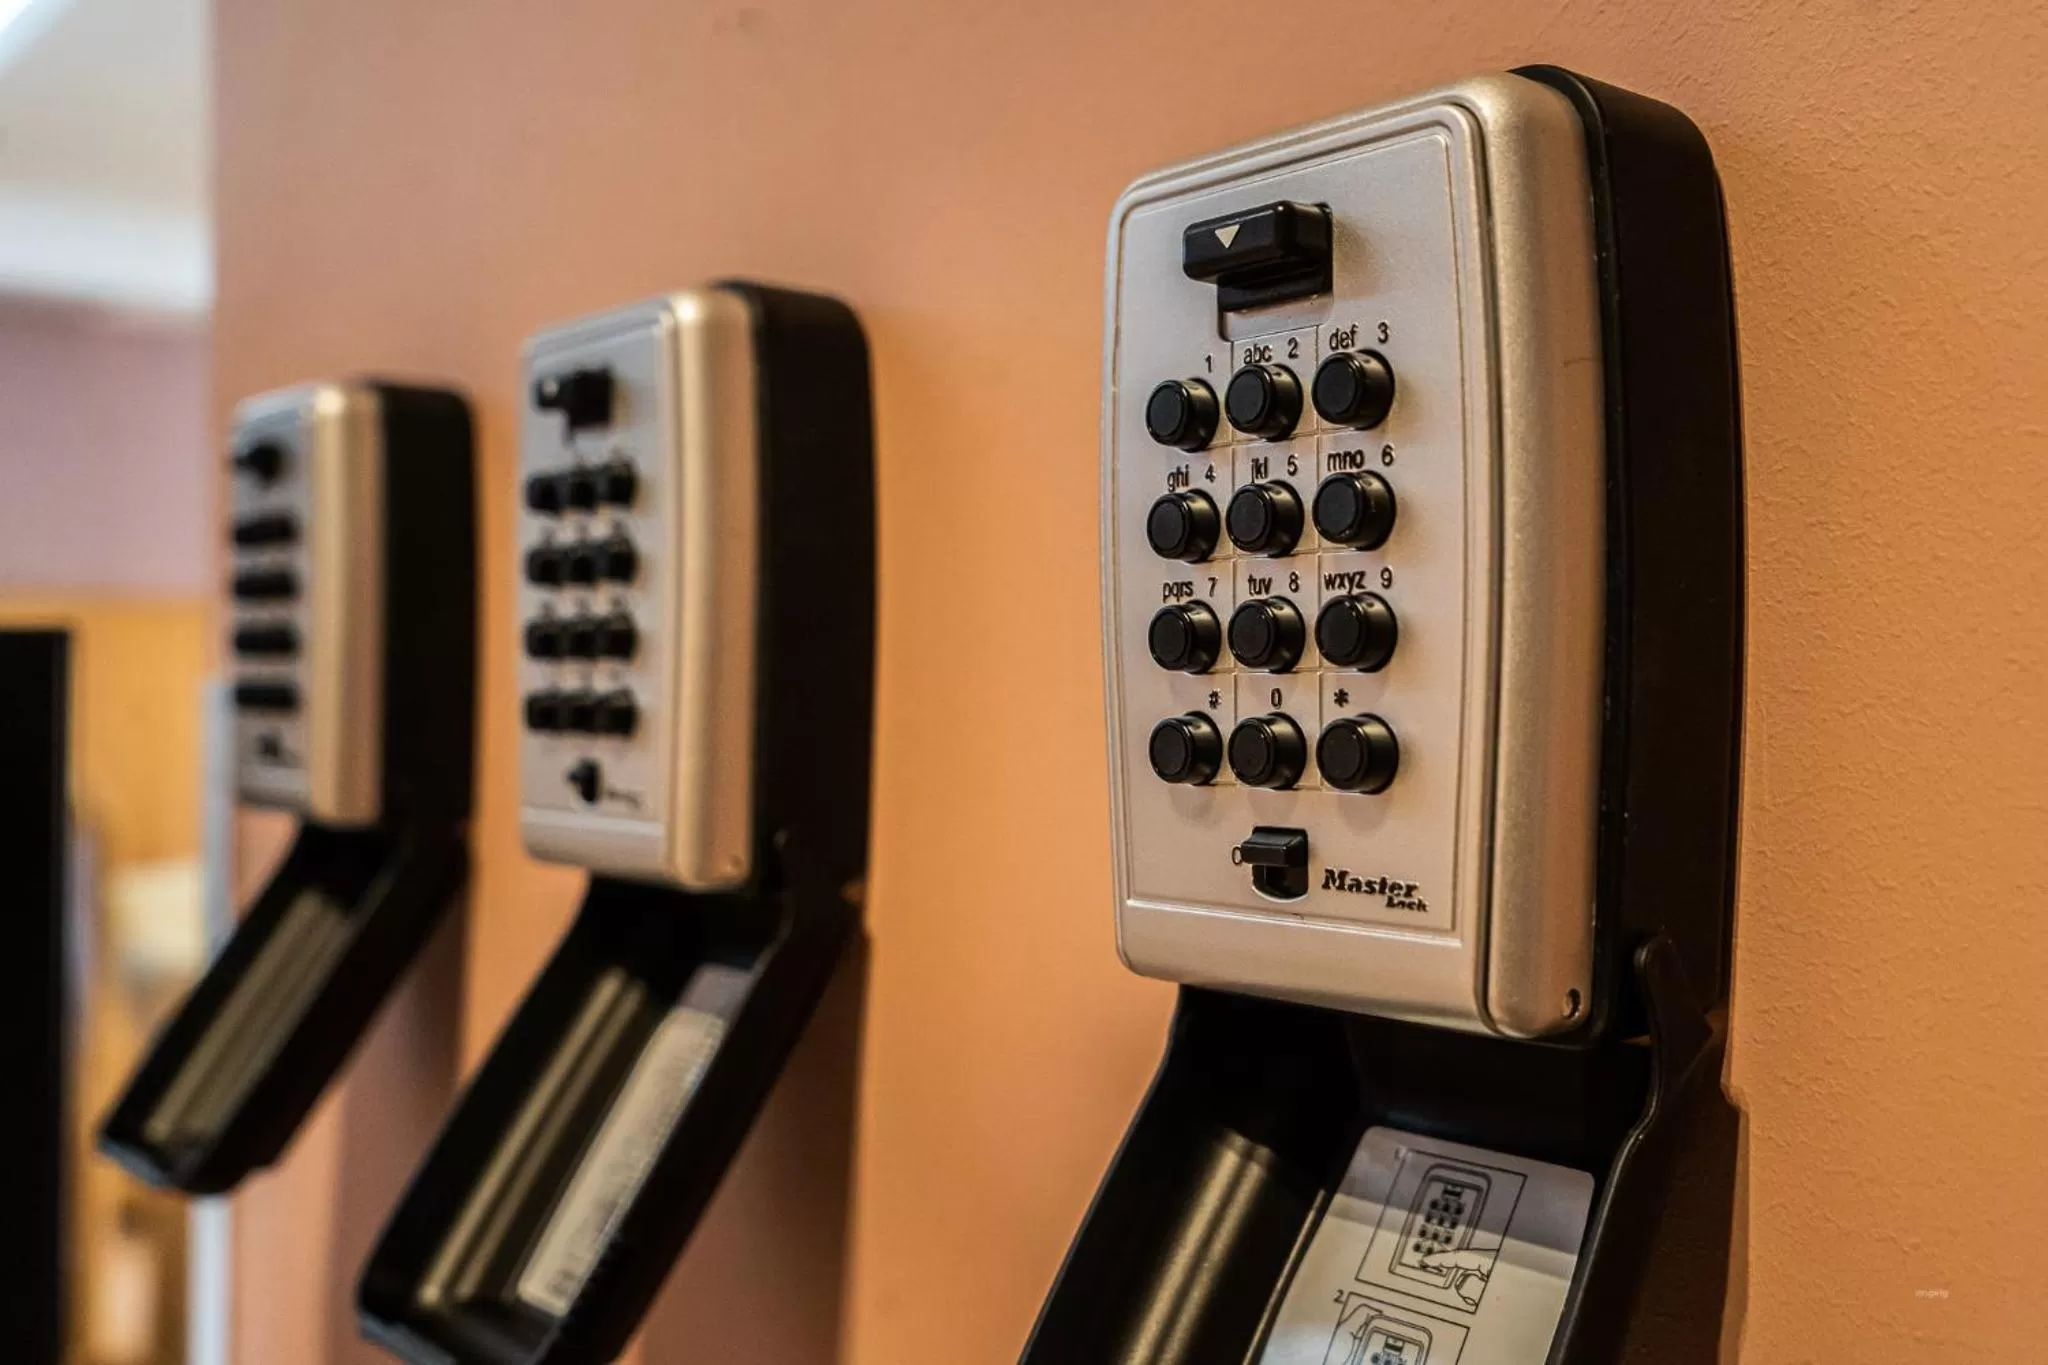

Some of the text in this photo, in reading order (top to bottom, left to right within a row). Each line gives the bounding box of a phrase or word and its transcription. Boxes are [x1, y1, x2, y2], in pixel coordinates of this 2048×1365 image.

[1329, 322, 1389, 349] def 3
[1205, 356, 1212, 373] 1
[1244, 338, 1299, 364] abc 2
[1250, 454, 1298, 485] jkl 5
[1327, 444, 1394, 472] mno 6
[1167, 465, 1215, 491] ghi 4
[1162, 577, 1217, 604] pqrs 7
[1248, 572, 1300, 595] tuv 8
[1324, 567, 1392, 596] wxyz 9
[1321, 868, 1420, 899] Master
[1333, 1290, 1345, 1303] 2
